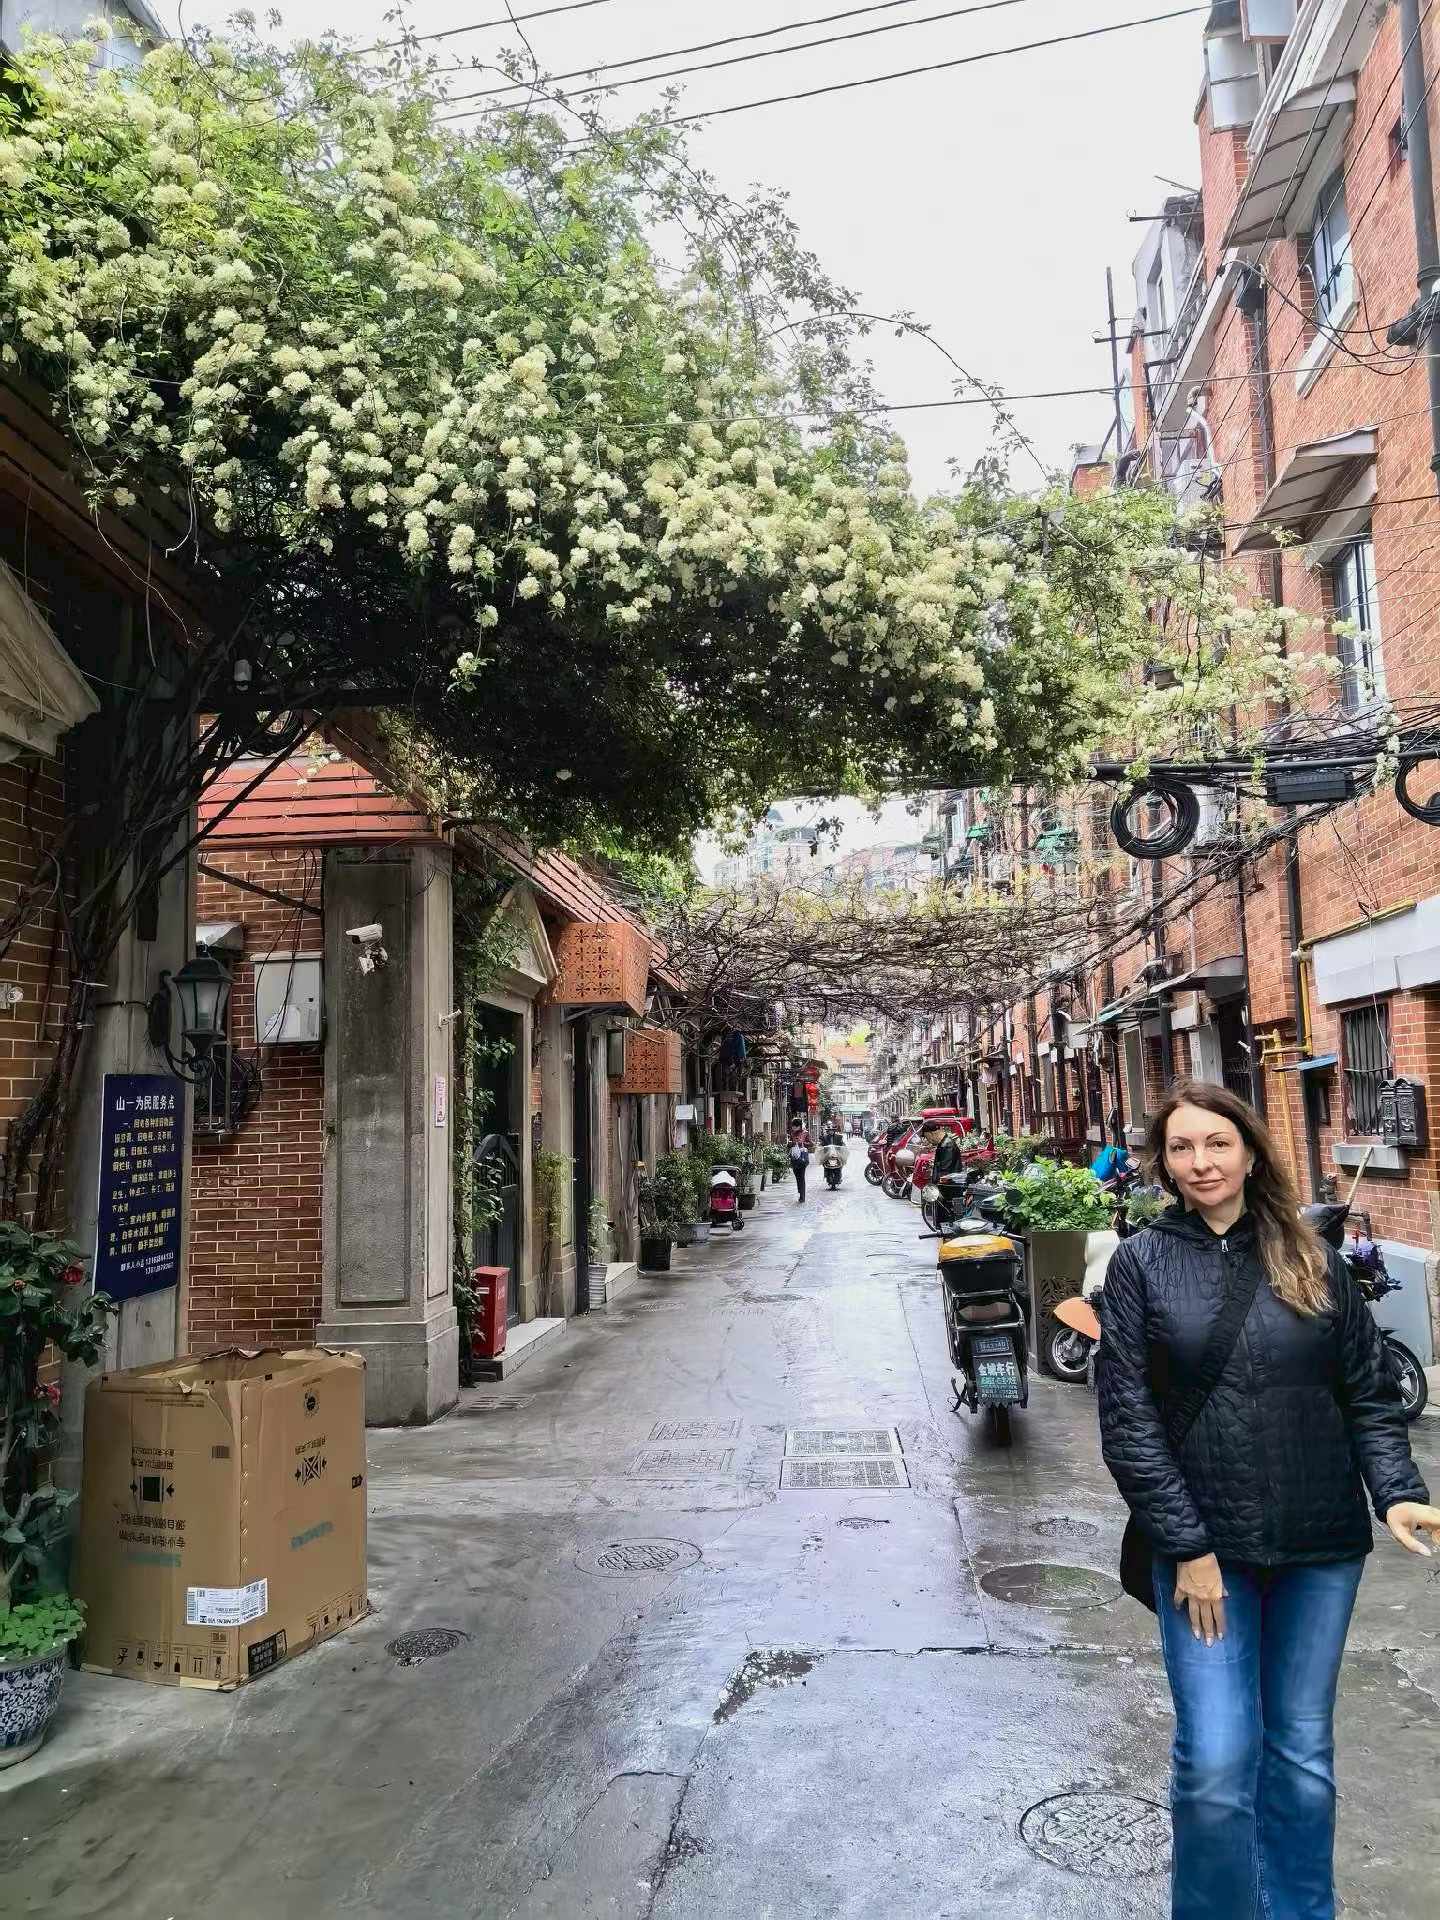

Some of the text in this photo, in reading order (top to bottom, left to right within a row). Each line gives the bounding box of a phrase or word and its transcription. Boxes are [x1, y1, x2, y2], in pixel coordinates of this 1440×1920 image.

[116, 1095, 175, 1111] 山一为民服务点
